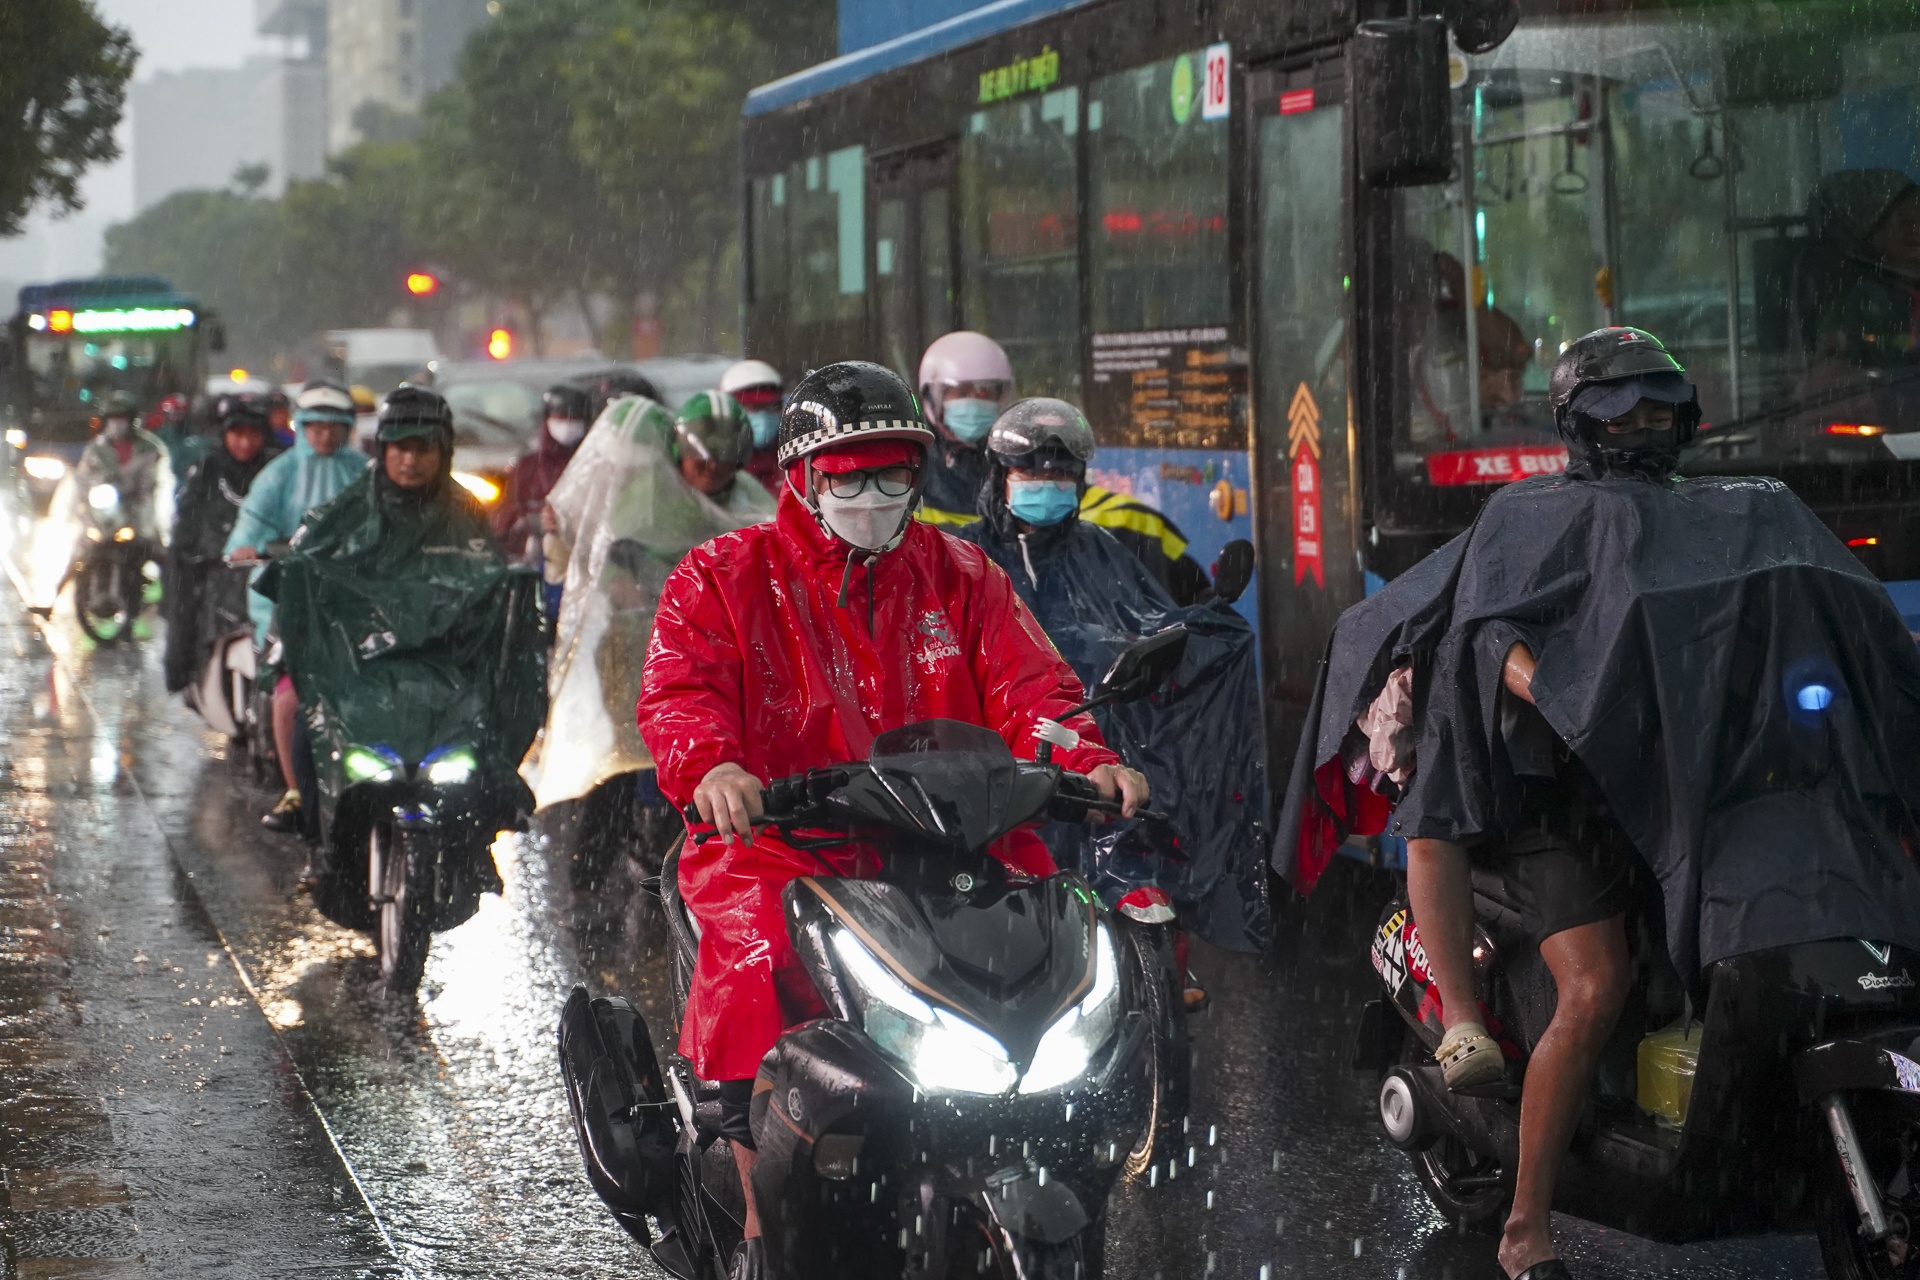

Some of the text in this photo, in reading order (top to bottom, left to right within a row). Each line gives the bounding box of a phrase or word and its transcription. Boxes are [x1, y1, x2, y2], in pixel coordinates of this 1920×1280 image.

[1207, 56, 1225, 106] 18
[1474, 455, 1512, 475] XE
[916, 645, 960, 664] SAIGON
[1858, 968, 1915, 989] Diamond
